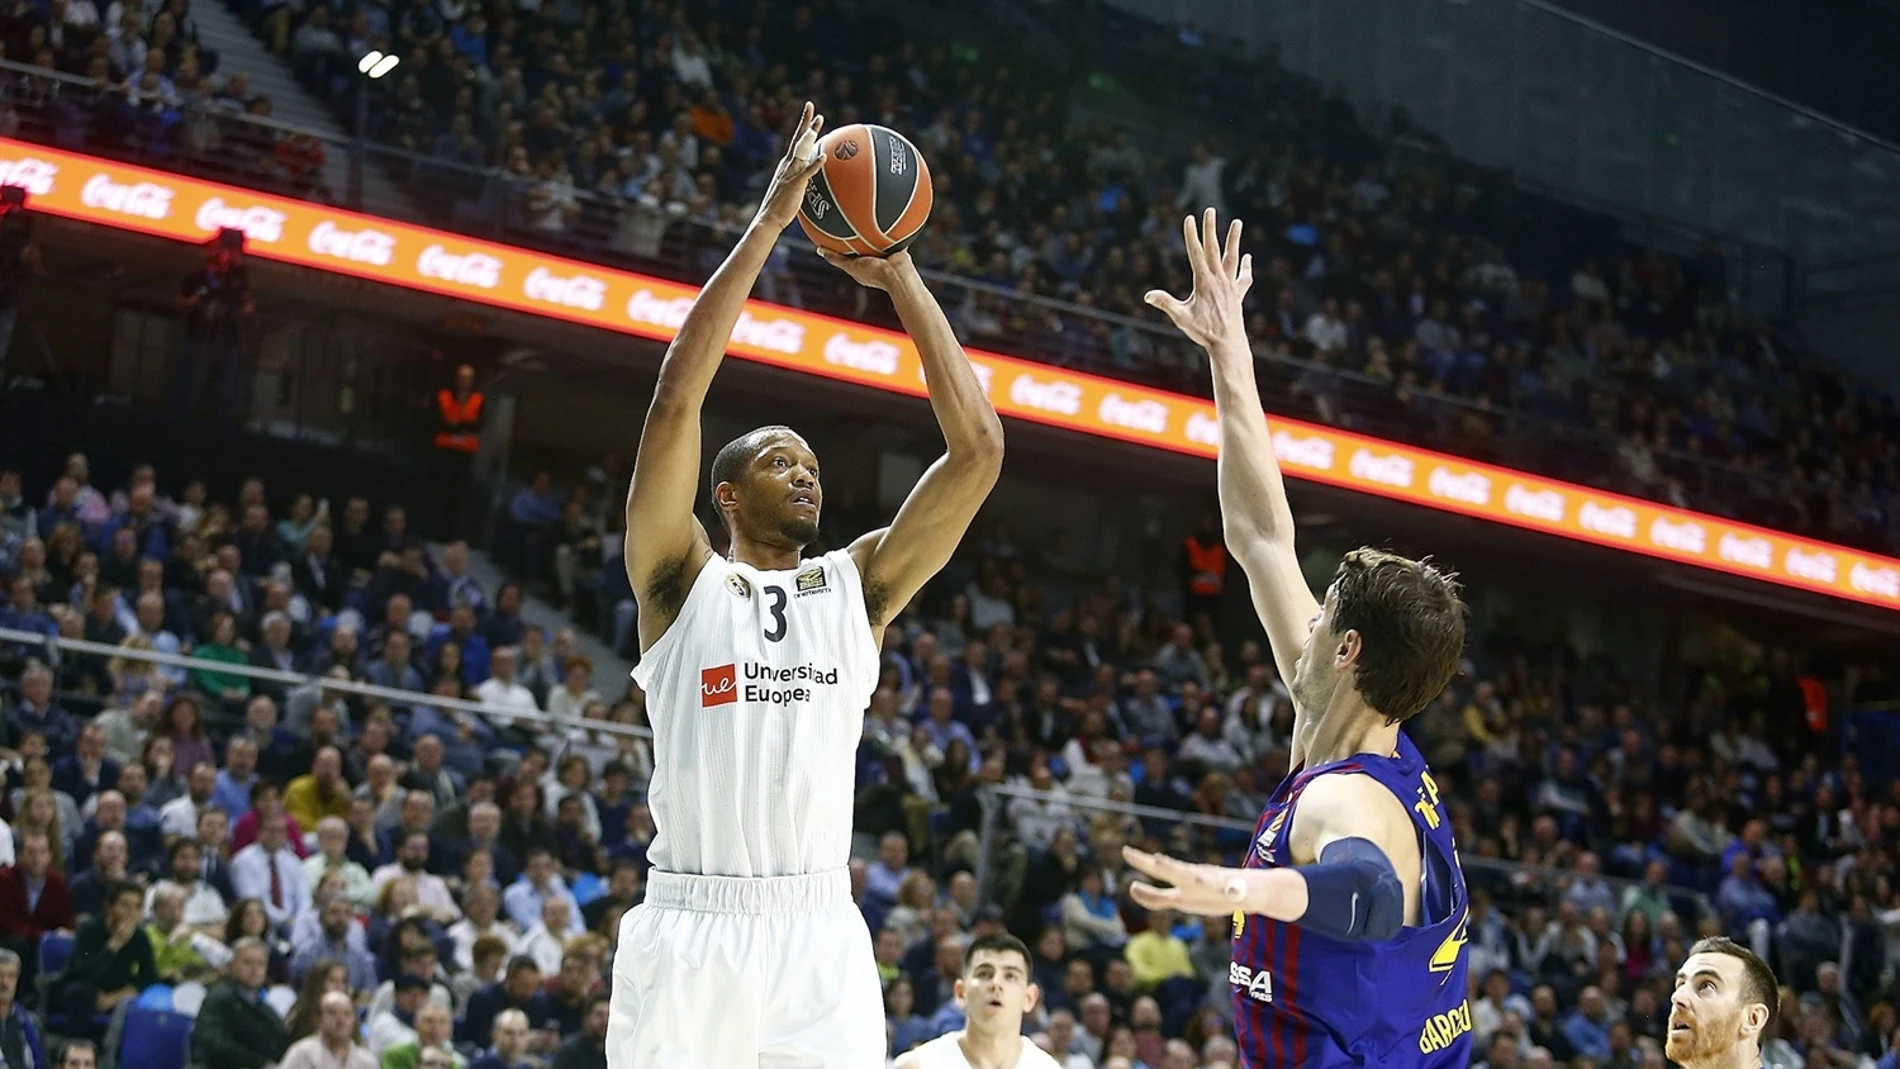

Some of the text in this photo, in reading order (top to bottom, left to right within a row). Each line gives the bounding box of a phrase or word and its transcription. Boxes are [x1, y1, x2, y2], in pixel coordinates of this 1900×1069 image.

[763, 584, 788, 642] 3
[744, 662, 838, 685] Unversiad
[745, 684, 811, 707] Euopea
